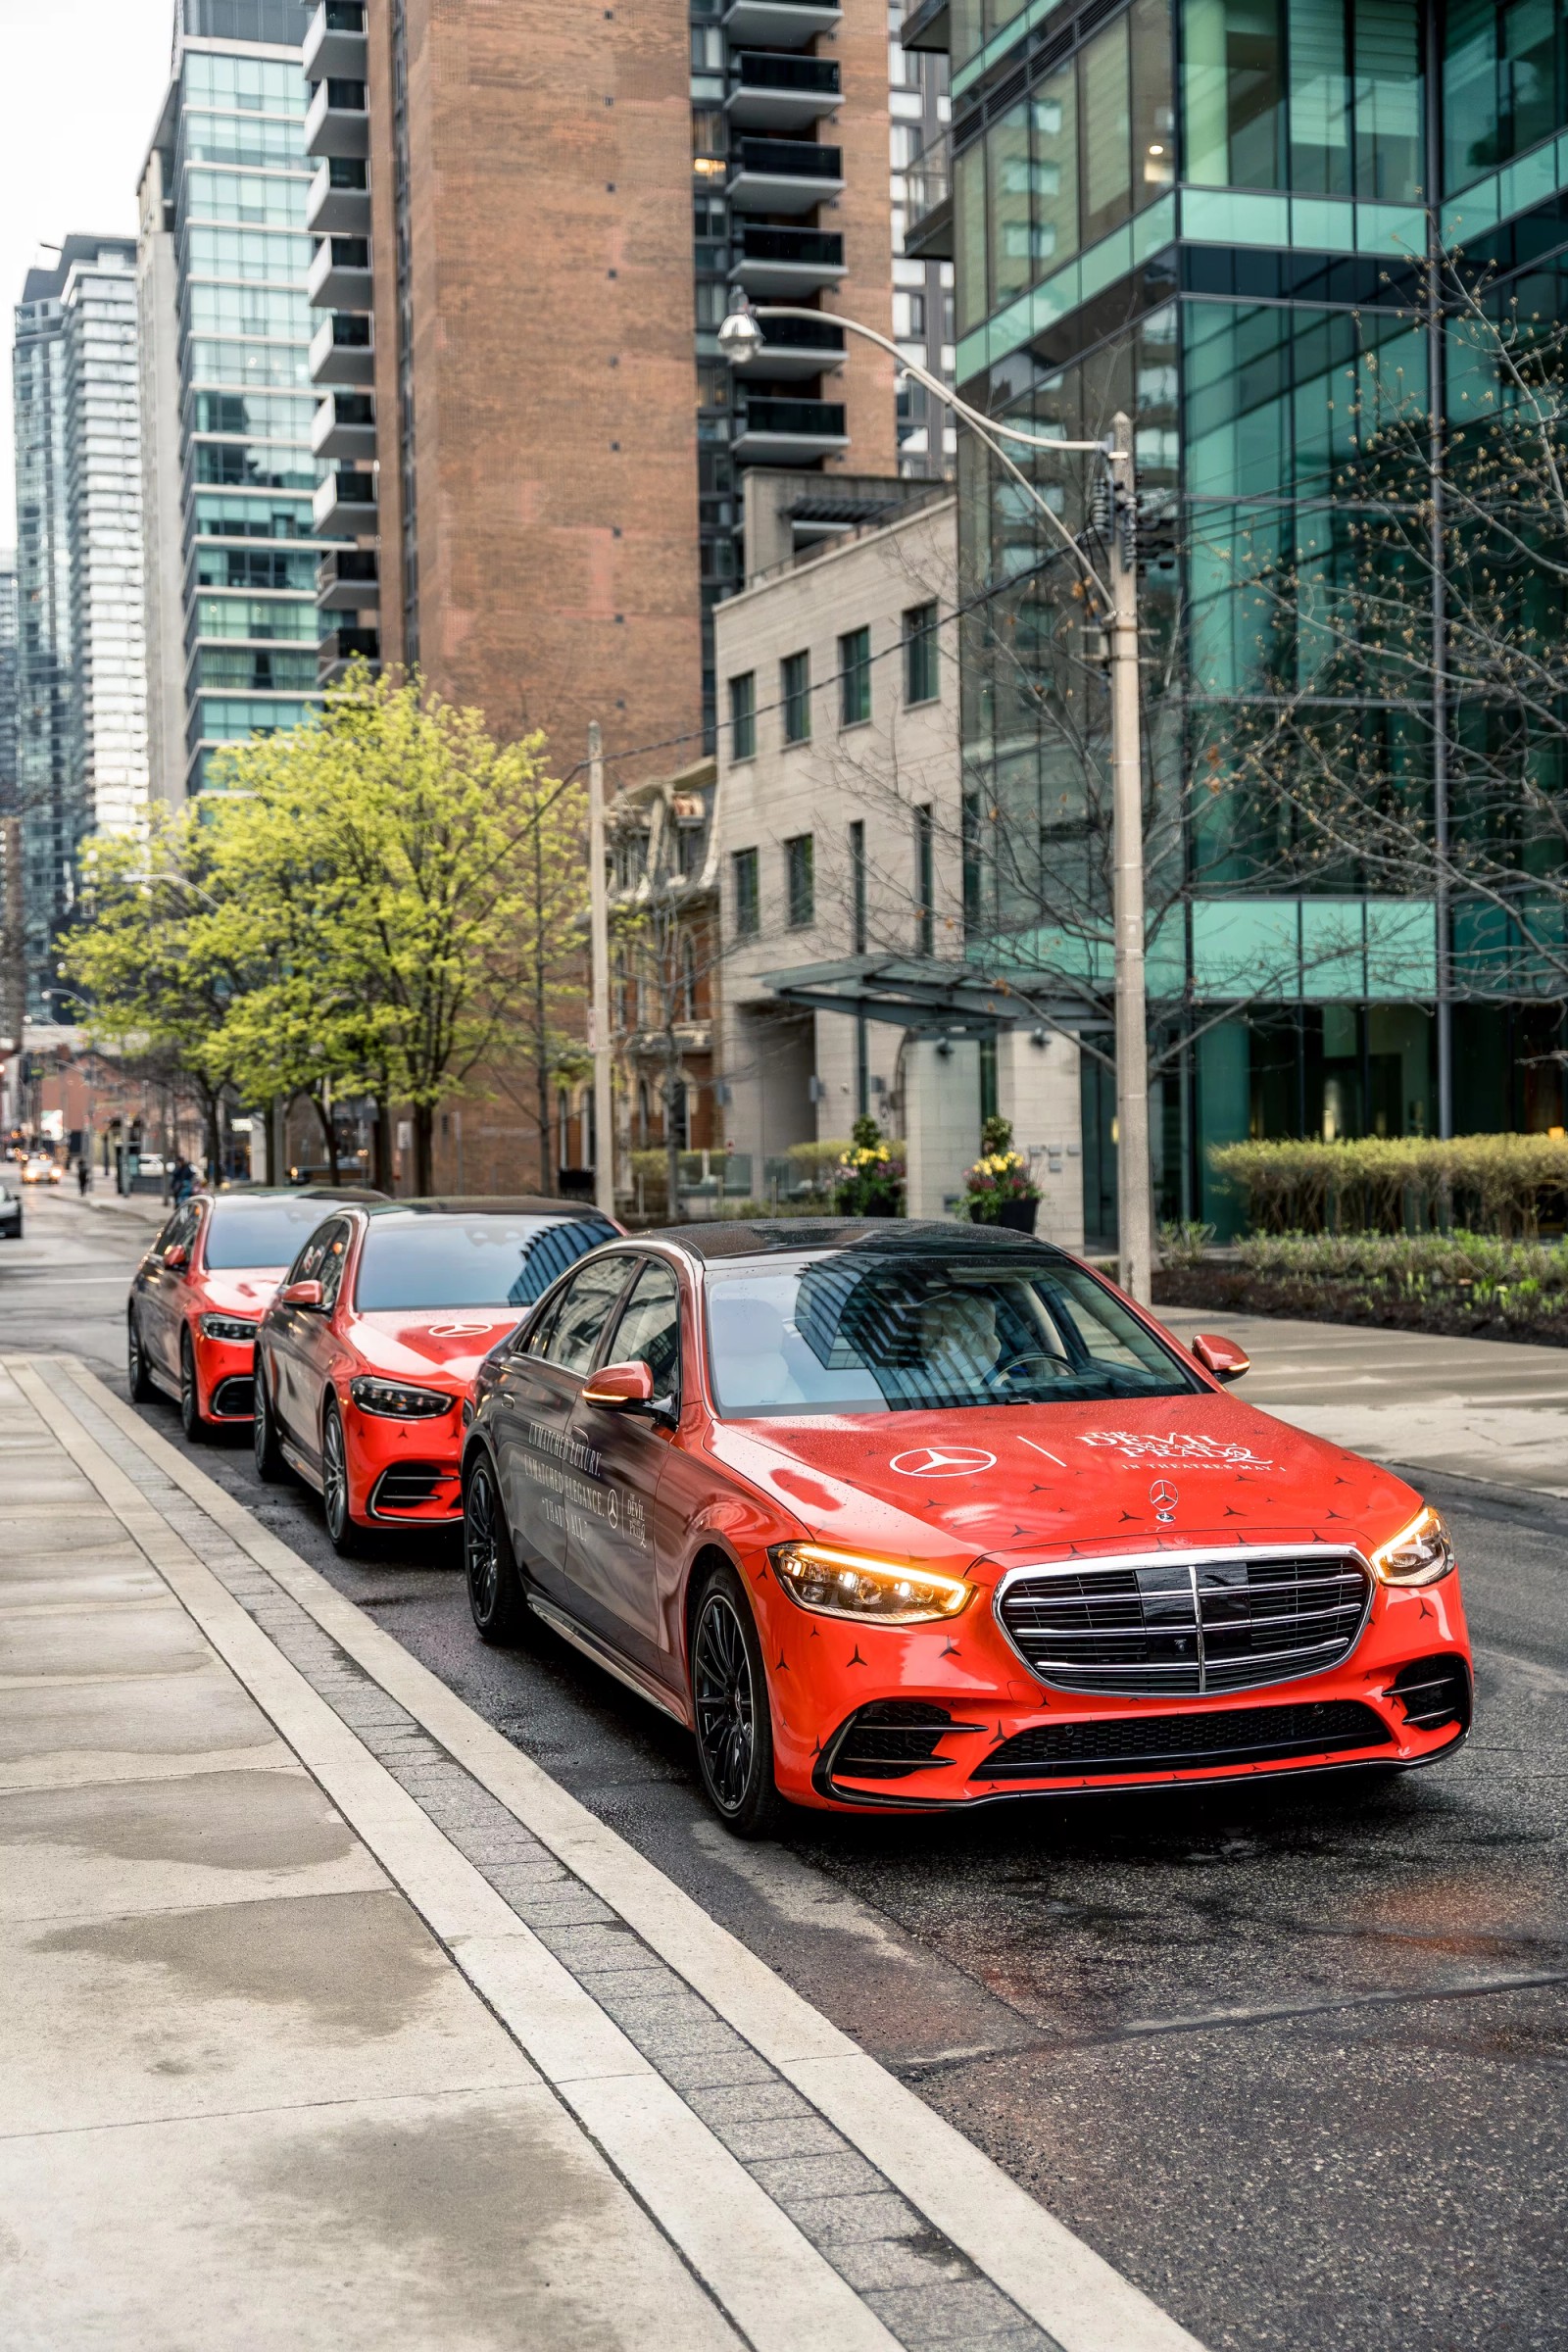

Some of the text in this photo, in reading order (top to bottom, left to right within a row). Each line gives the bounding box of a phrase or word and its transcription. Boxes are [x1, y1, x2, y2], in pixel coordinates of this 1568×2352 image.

[528, 1422, 602, 1477] UNMATCHED LUXURY.
[1075, 1432, 1237, 1446] DEVIL
[523, 1454, 605, 1517] UNMATCHED ELEGANCE.
